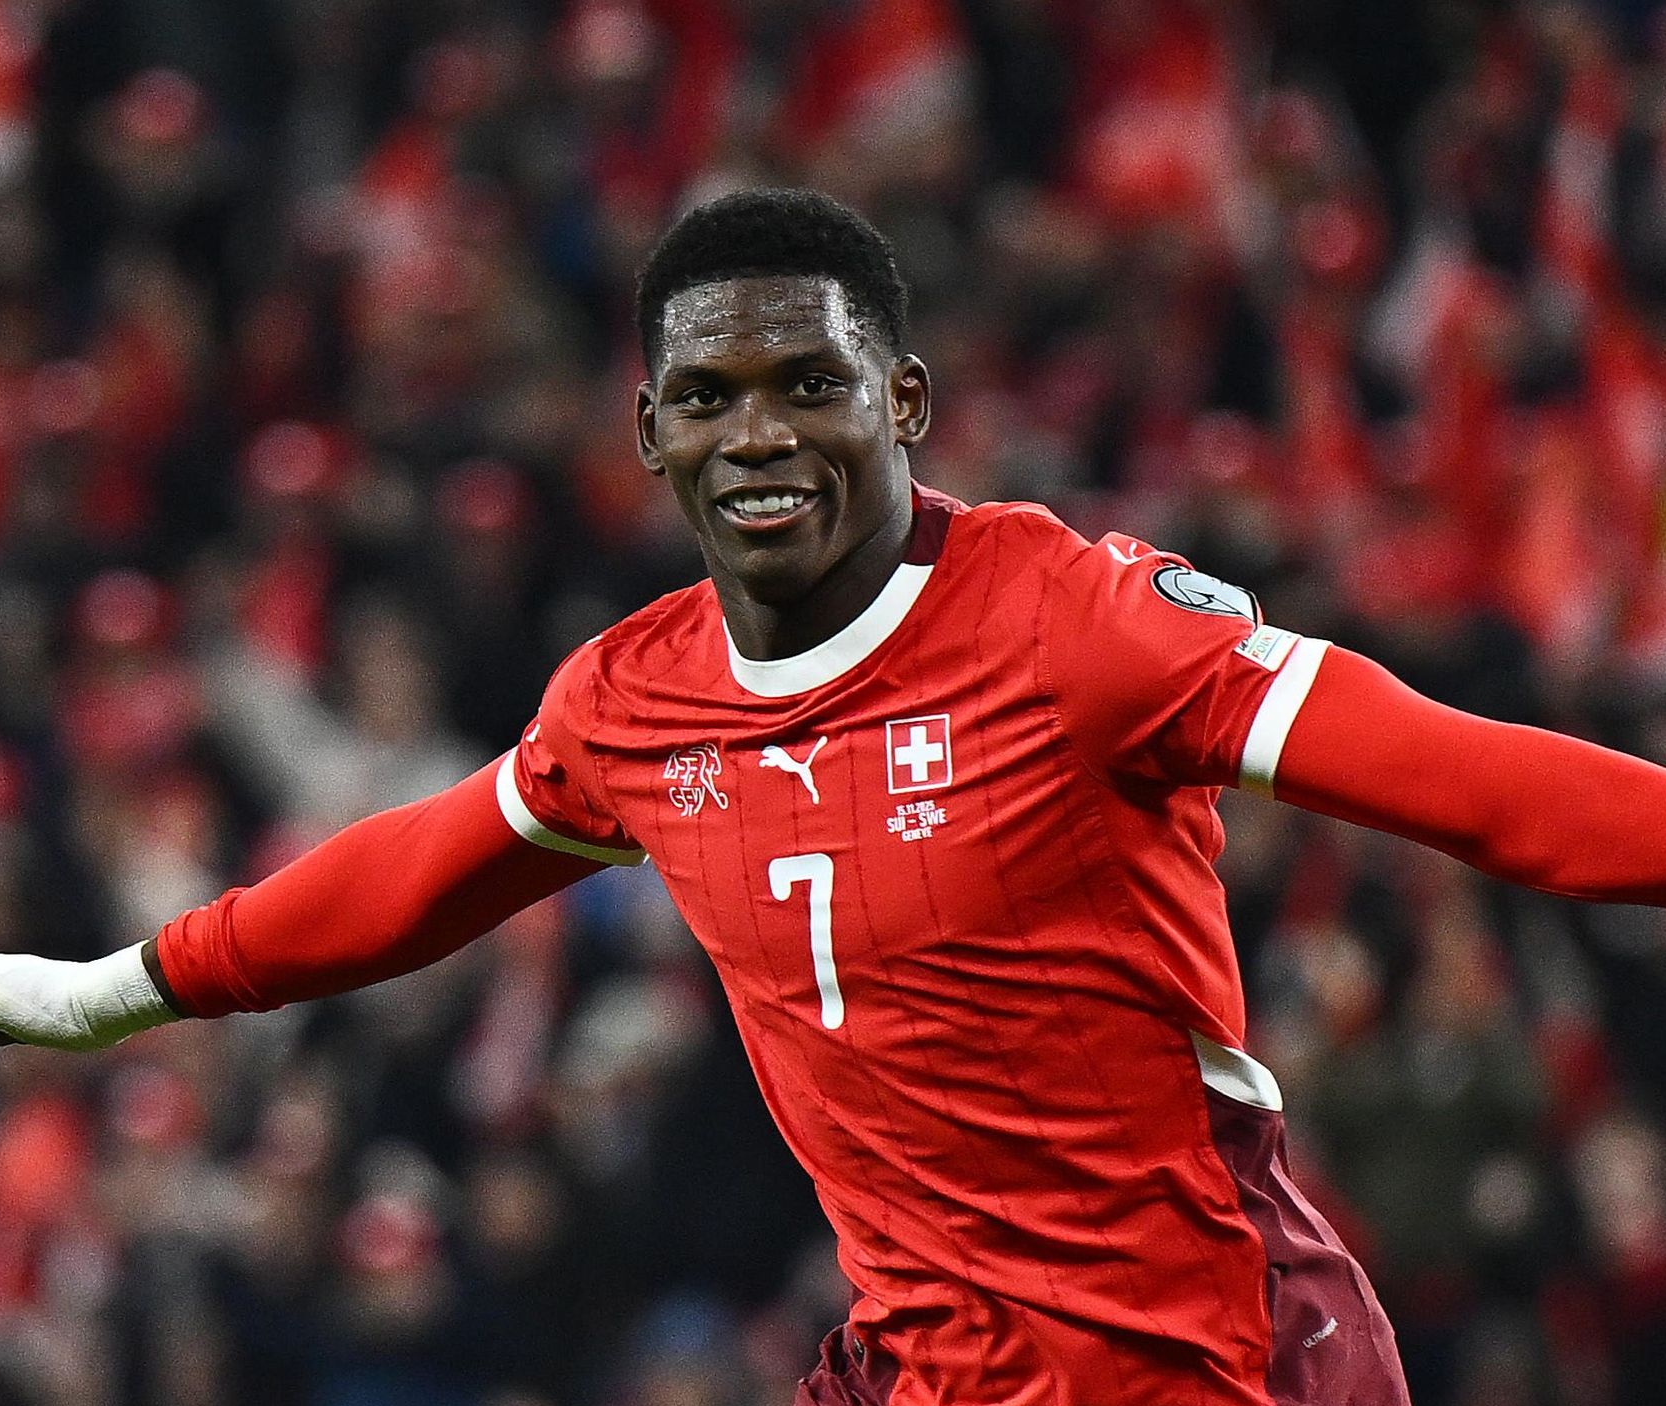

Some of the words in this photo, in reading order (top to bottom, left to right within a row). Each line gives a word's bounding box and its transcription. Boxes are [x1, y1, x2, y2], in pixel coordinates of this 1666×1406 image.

[887, 816, 906, 833] SUI
[918, 808, 947, 827] SWE
[768, 853, 845, 1030] 7
